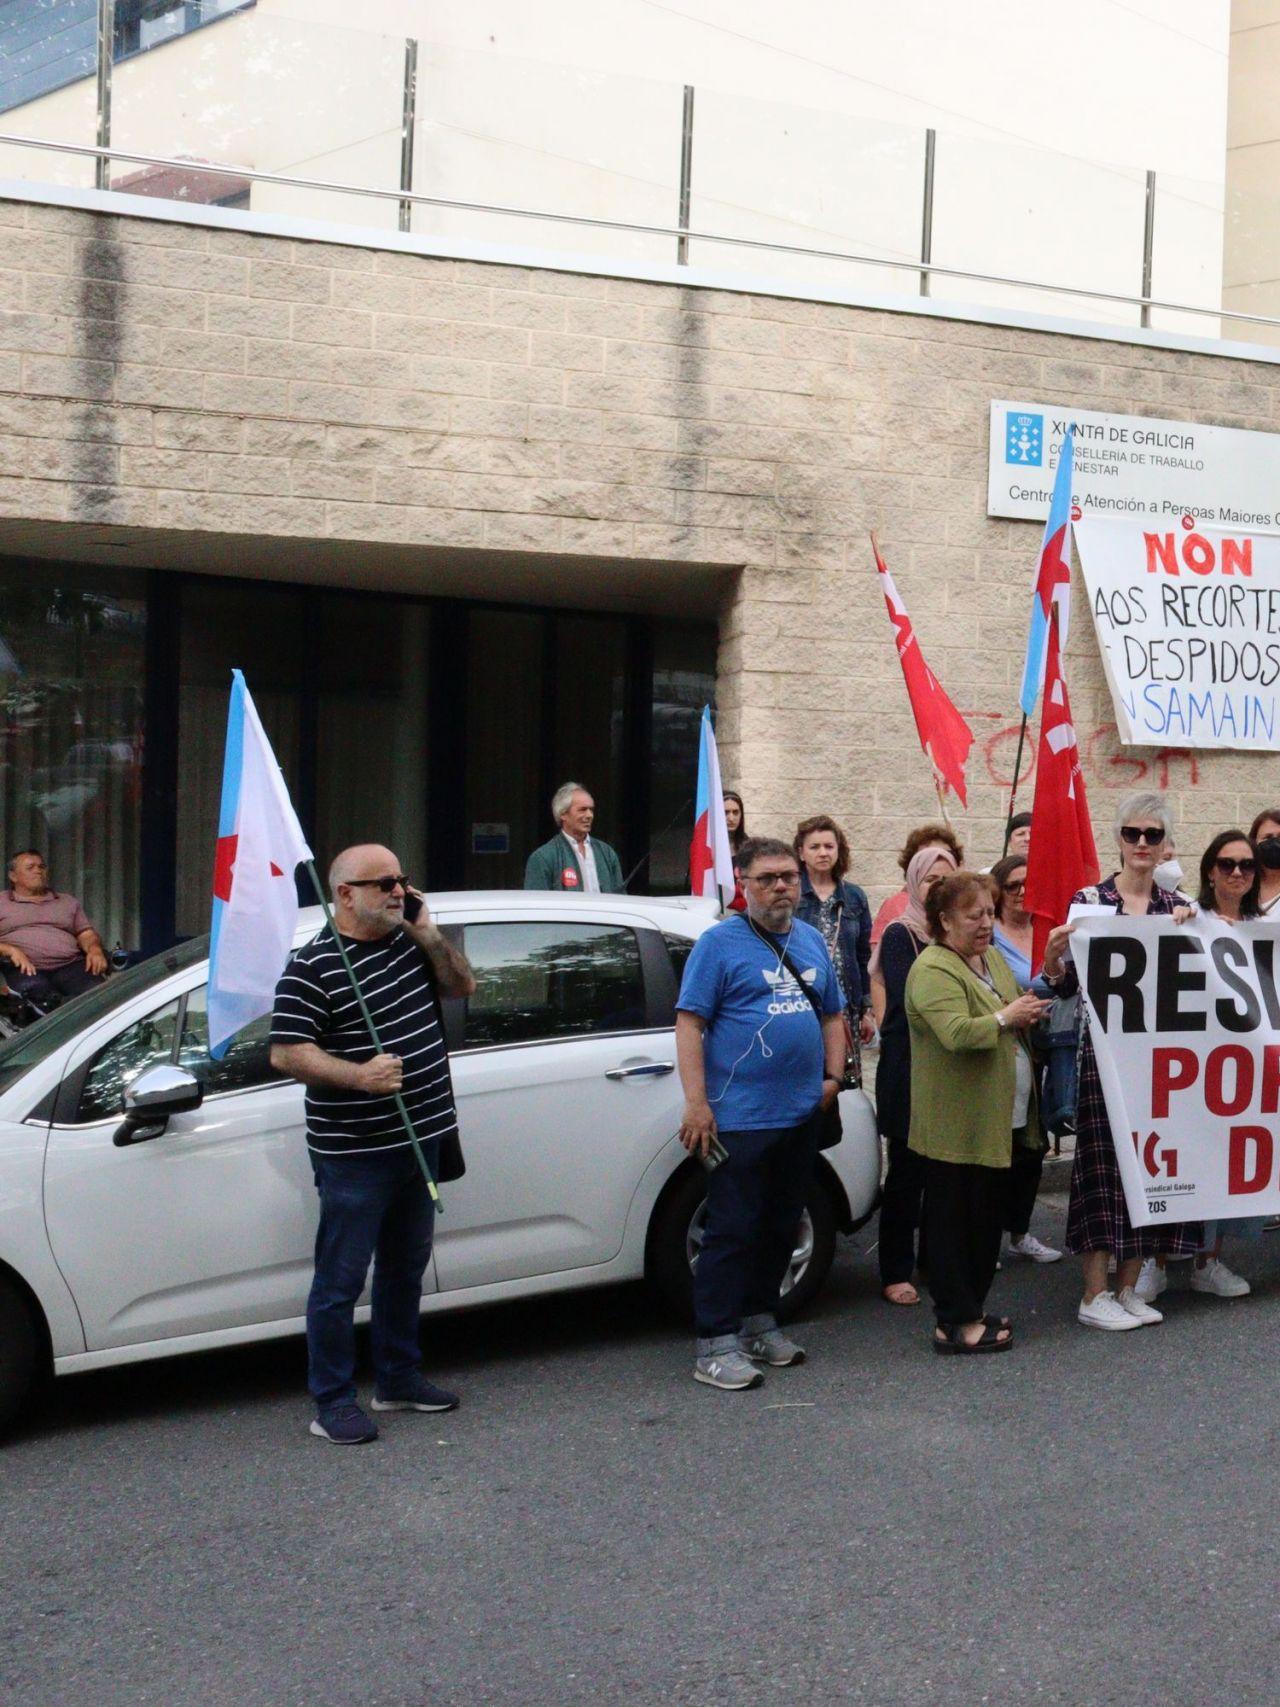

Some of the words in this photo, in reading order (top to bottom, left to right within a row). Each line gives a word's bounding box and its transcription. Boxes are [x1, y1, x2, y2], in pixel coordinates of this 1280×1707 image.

[1109, 428, 1128, 443] DE
[1133, 431, 1194, 450] GALICIA
[1049, 459, 1056, 470] E
[1131, 453, 1146, 464] DE
[1149, 454, 1204, 471] TRABALLO
[1084, 493, 1145, 512] Atención
[1149, 502, 1158, 513] a
[1162, 501, 1215, 519] Persoas
[1219, 507, 1271, 525] Maiores
[1143, 532, 1252, 576] NON
[1095, 586, 1147, 629] AOS
[1124, 635, 1280, 686] DESPIDOS
[1143, 683, 1275, 740] SAMAIN
[767, 997, 813, 1015] adida
[1174, 1183, 1196, 1192] Galega
[707, 1362, 721, 1378] N
